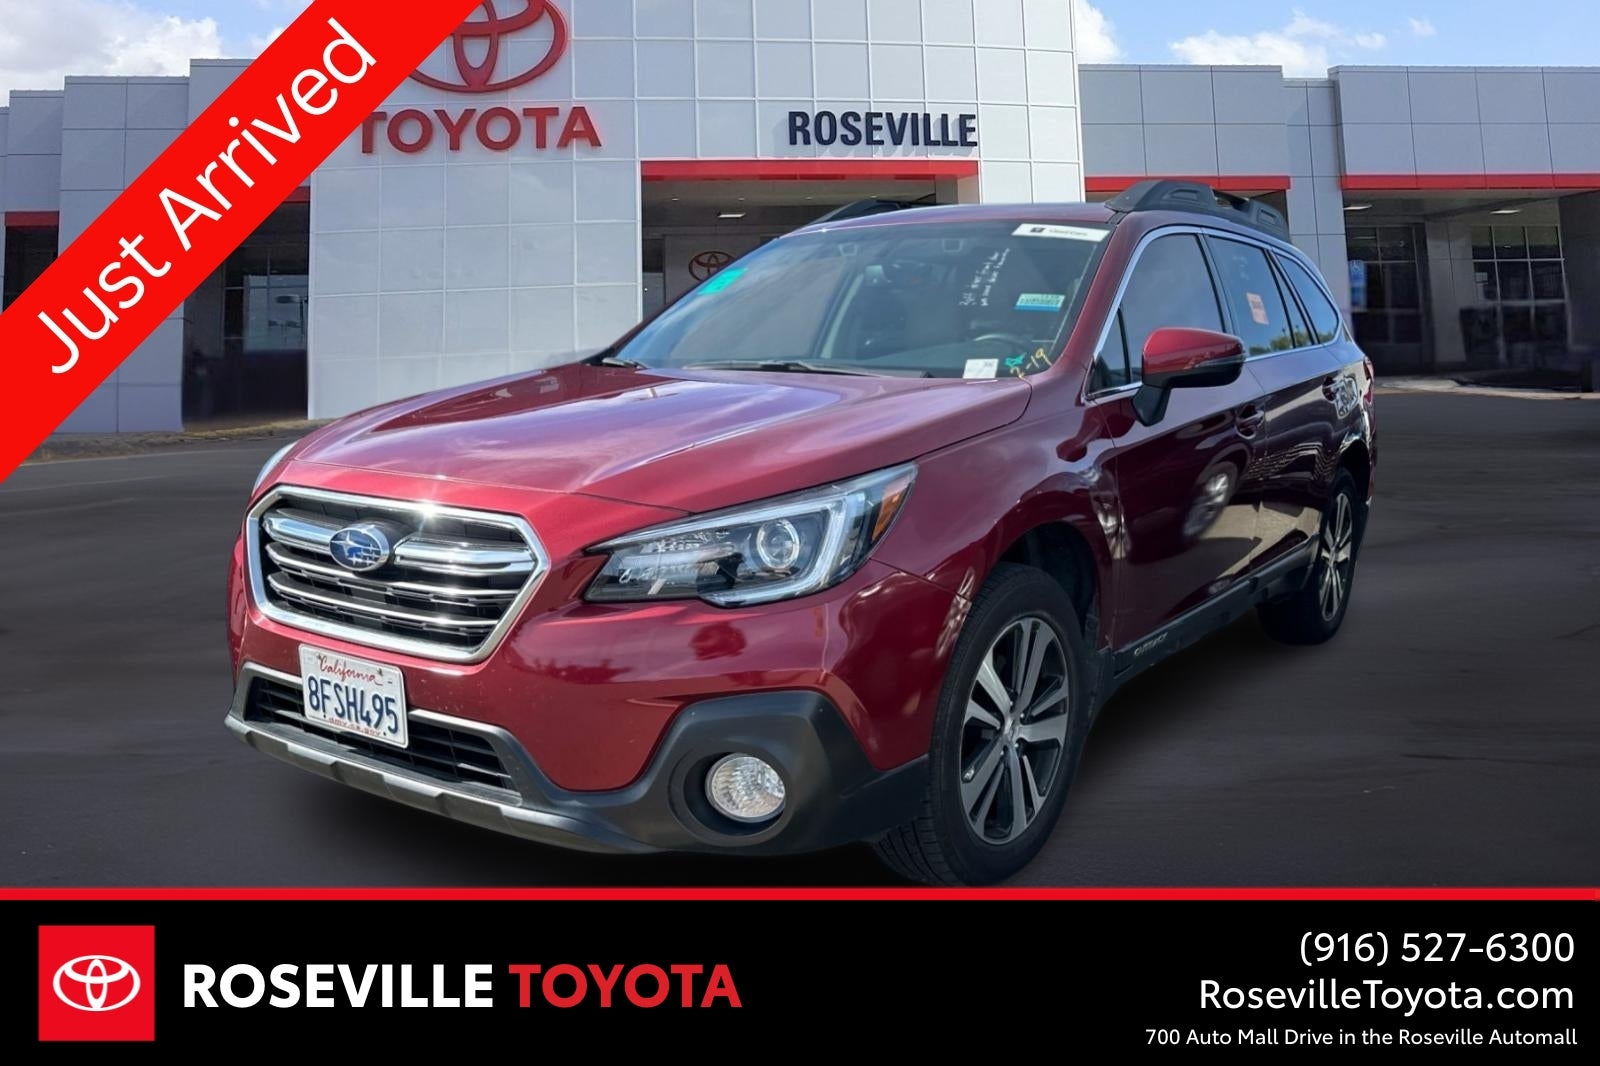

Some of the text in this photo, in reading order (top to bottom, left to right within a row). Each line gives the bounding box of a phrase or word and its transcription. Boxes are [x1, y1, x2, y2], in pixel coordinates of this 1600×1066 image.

[361, 106, 602, 154] TOYOTA
[788, 110, 978, 147] ROSEVILLE
[319, 655, 384, 686] California
[307, 675, 399, 735] 8FSH495
